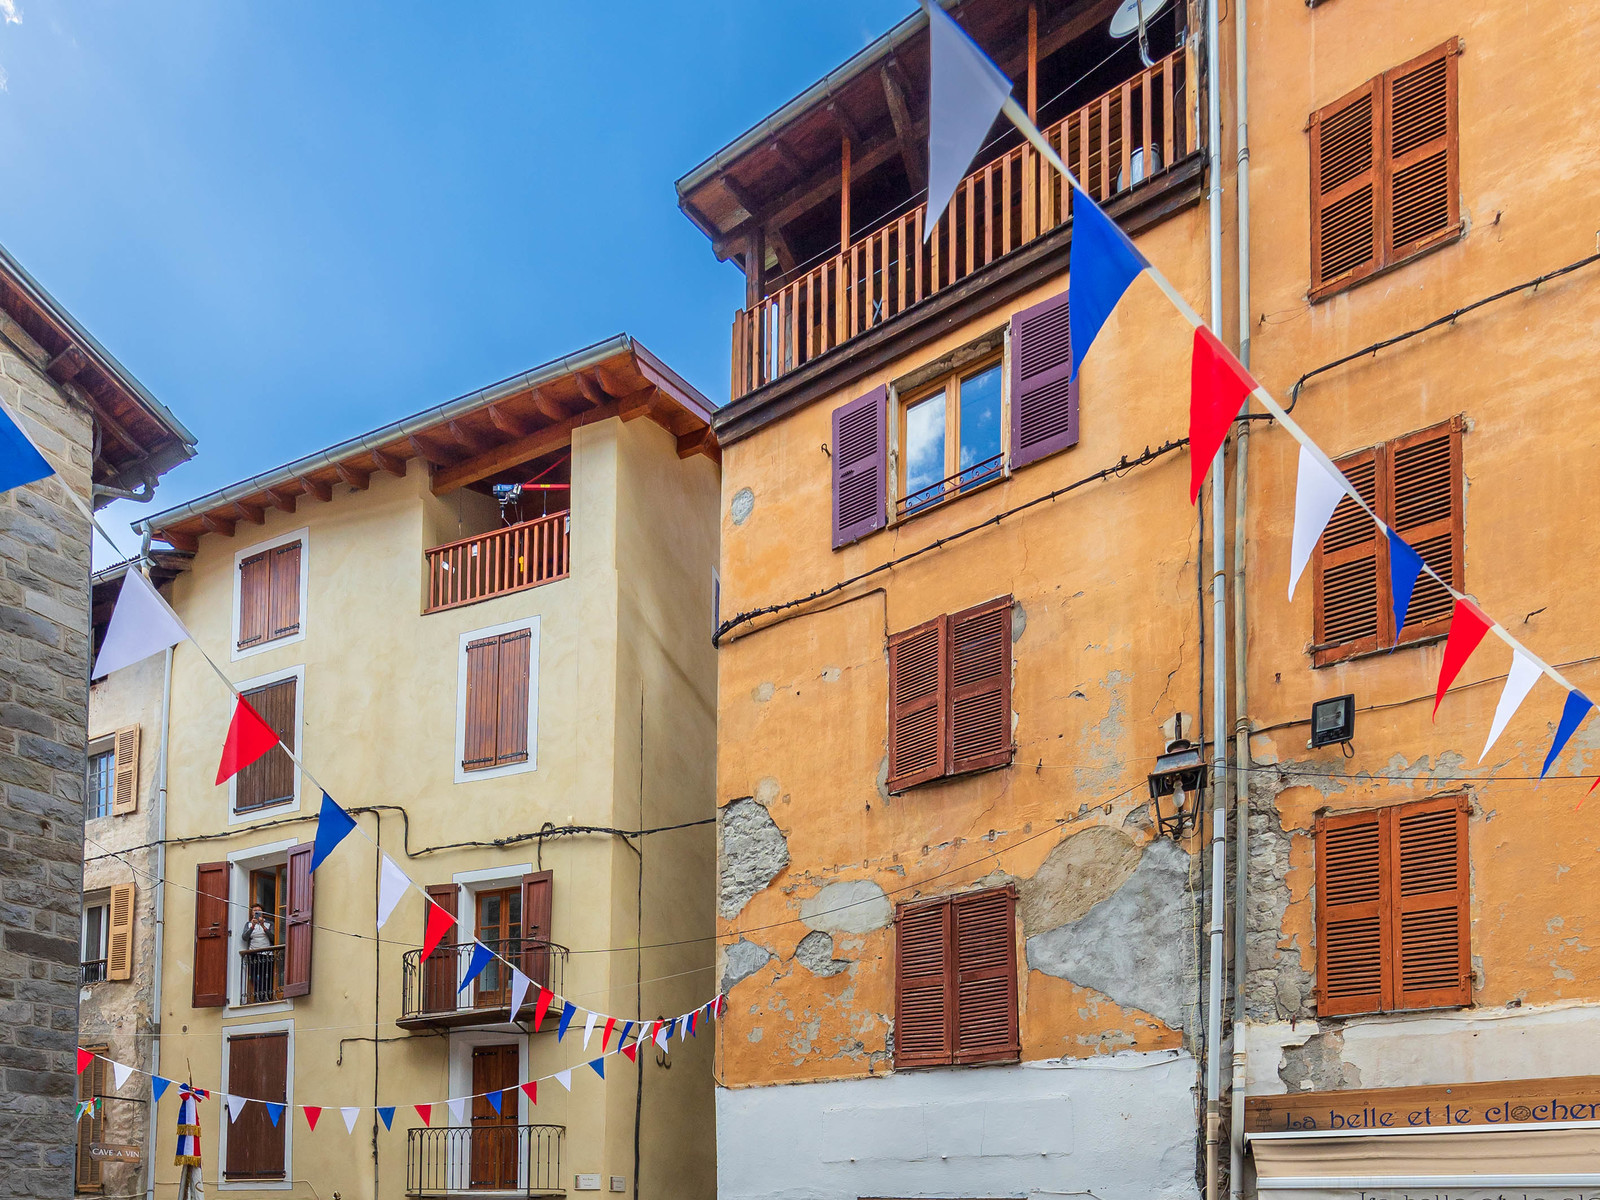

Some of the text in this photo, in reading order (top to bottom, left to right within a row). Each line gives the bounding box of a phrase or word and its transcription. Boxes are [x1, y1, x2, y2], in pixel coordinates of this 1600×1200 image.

[1286, 1112, 1317, 1130] La
[1329, 1107, 1395, 1129] belle
[1407, 1106, 1432, 1126] et
[1445, 1104, 1472, 1125] le
[92, 1148, 113, 1157] CAVE
[125, 1150, 140, 1158] VIN
